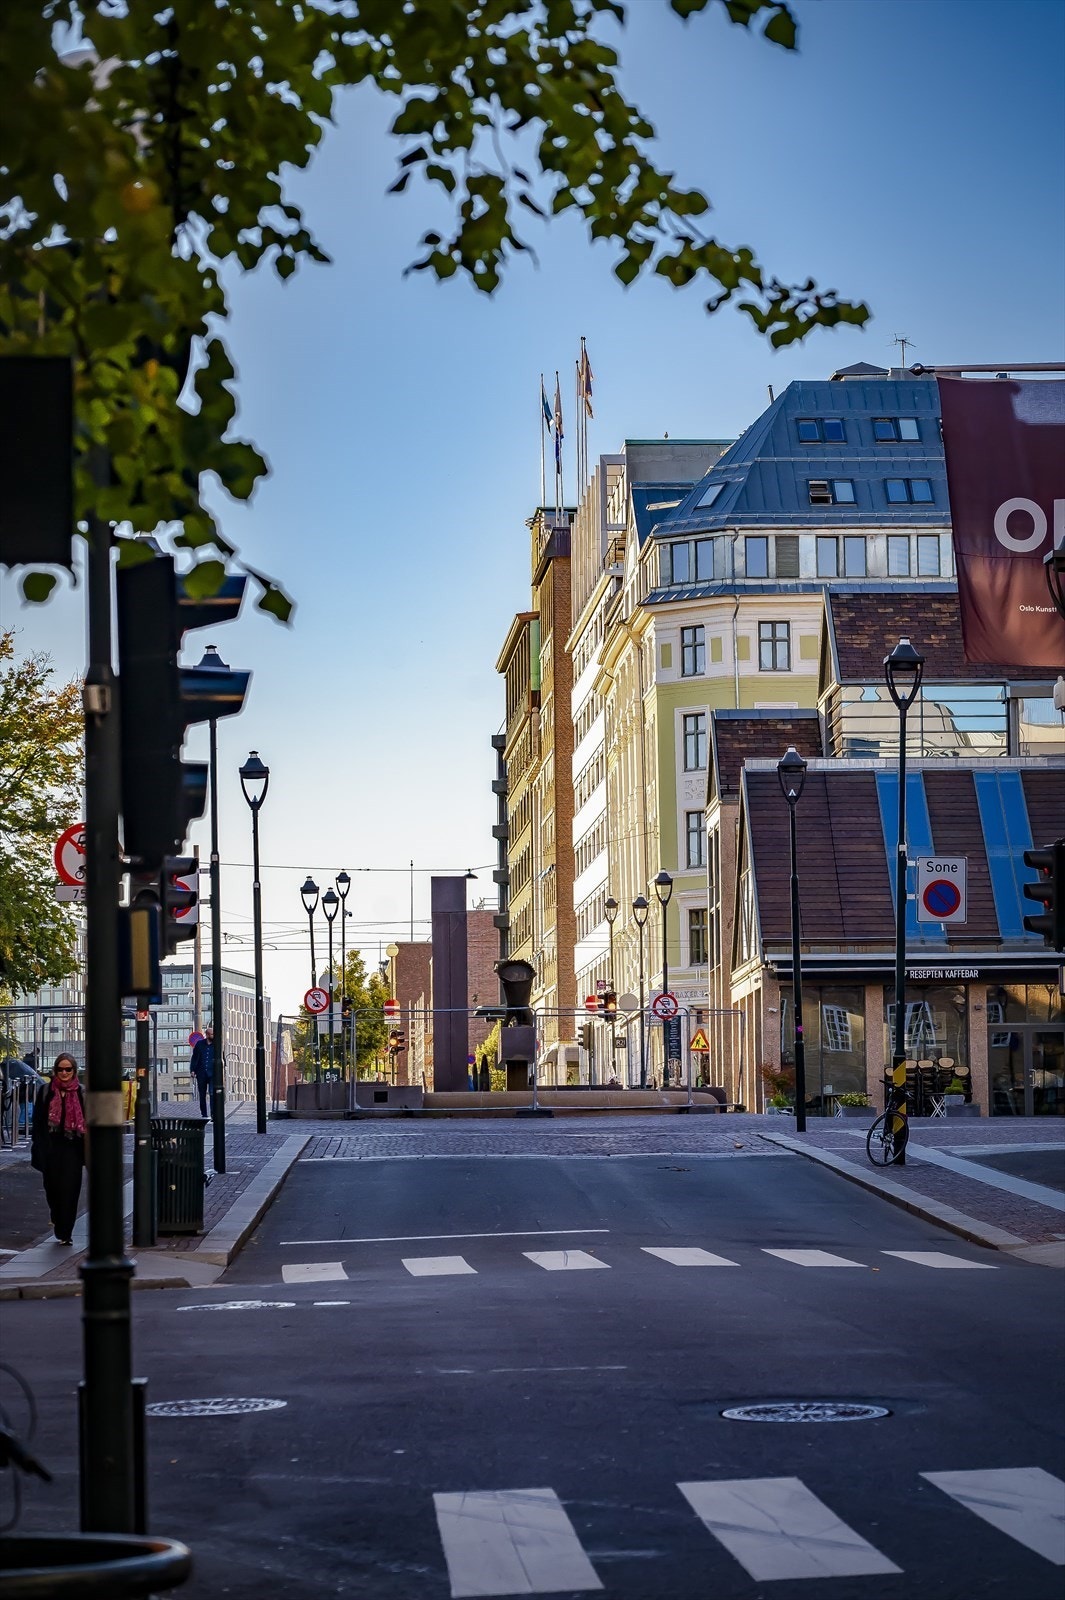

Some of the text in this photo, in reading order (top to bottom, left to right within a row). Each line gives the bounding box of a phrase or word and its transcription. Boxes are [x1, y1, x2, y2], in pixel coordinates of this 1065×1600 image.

[1019, 604, 1035, 612] Oslo
[926, 861, 958, 873] Sone
[910, 970, 943, 979] RESEPTEN
[945, 969, 979, 979] KAFFEBAR
